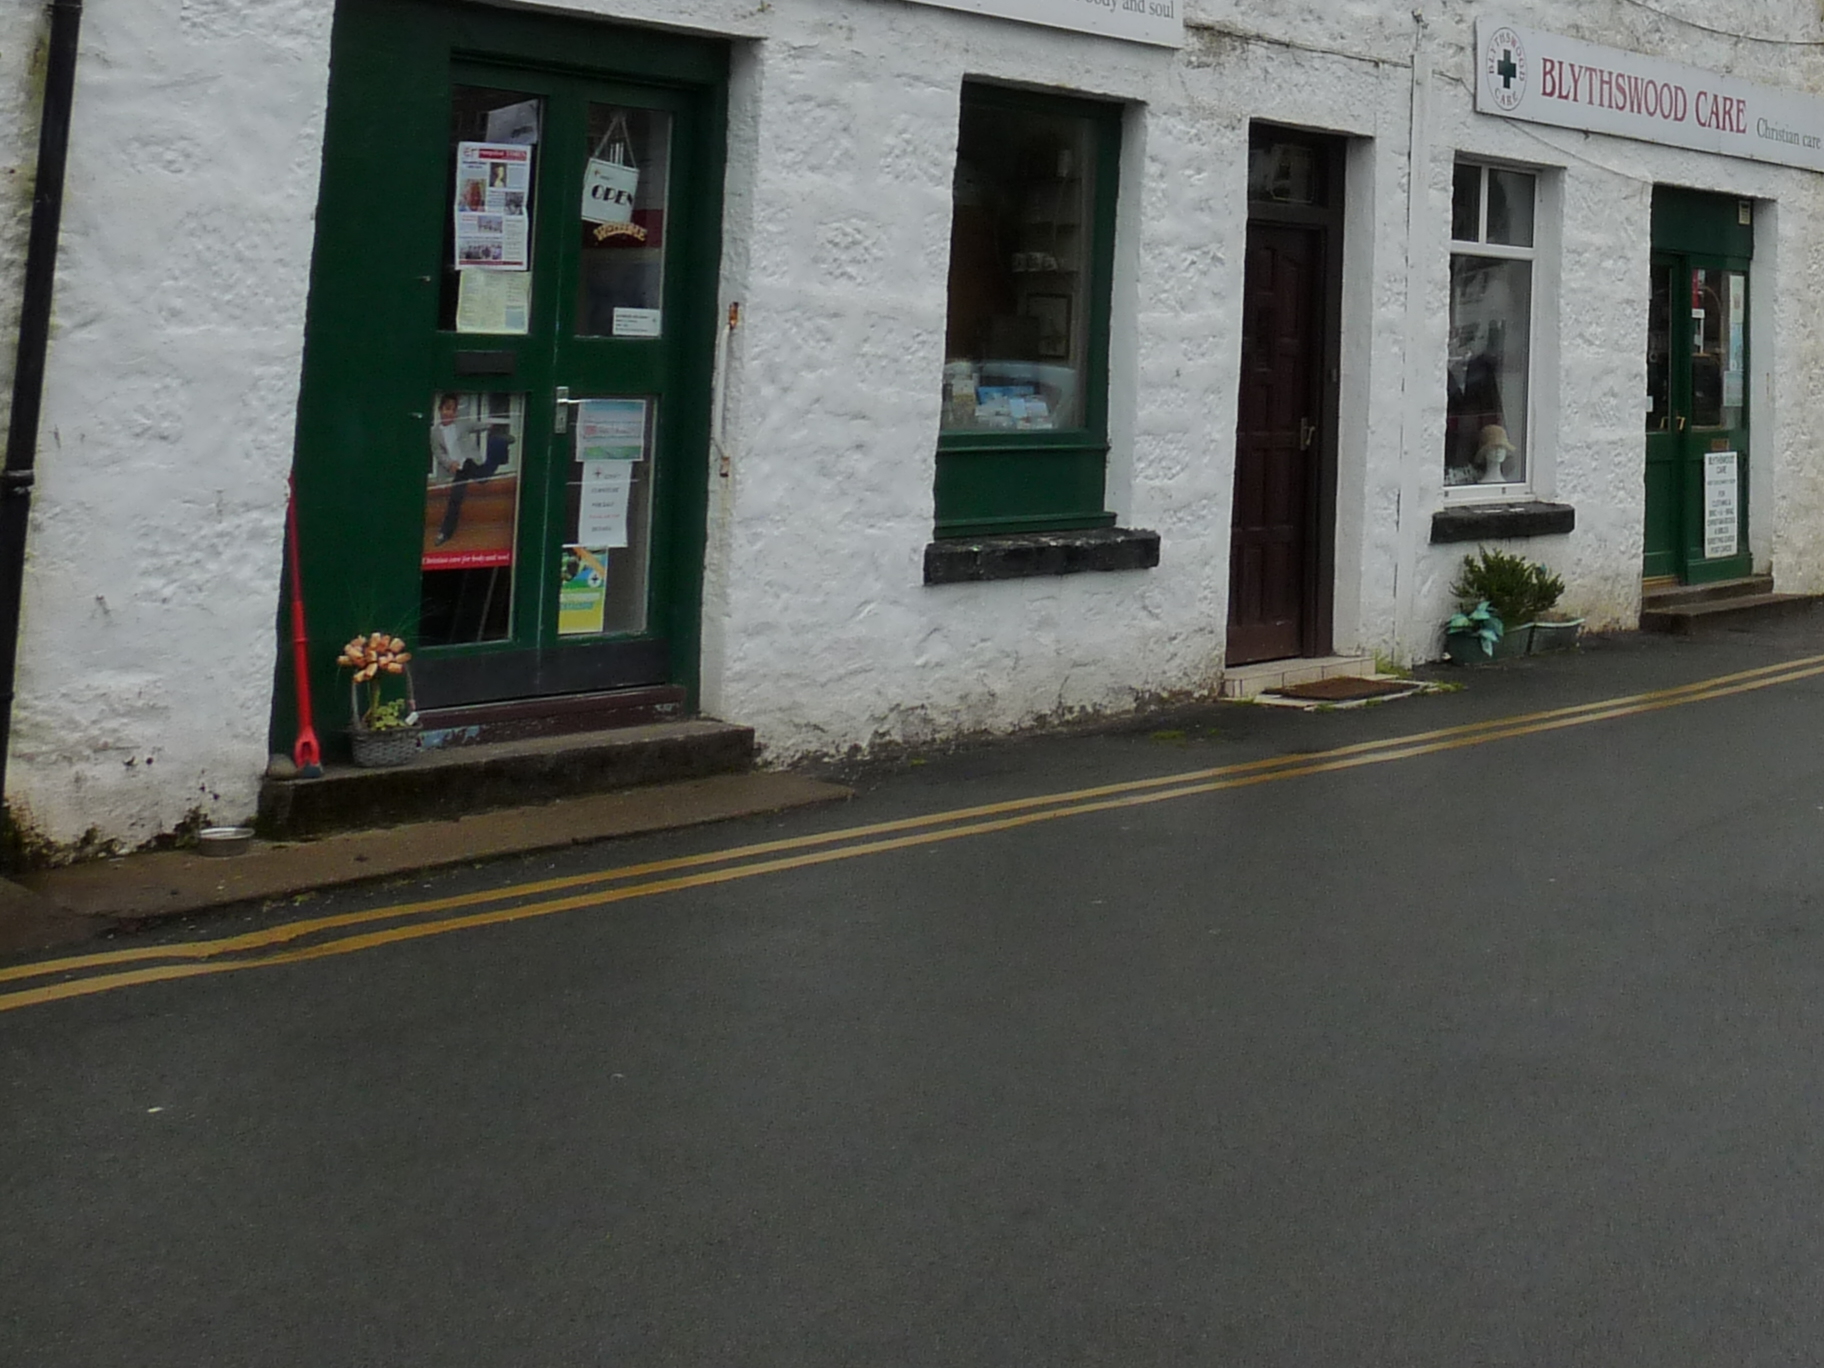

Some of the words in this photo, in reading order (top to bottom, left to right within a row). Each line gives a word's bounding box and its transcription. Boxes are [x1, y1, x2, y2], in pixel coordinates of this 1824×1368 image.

[1149, 0, 1175, 19] soul
[1541, 57, 1688, 122] BLYTHSWOOD
[1695, 90, 1748, 134] CARE
[1756, 117, 1800, 145] Christian
[1802, 132, 1822, 150] care
